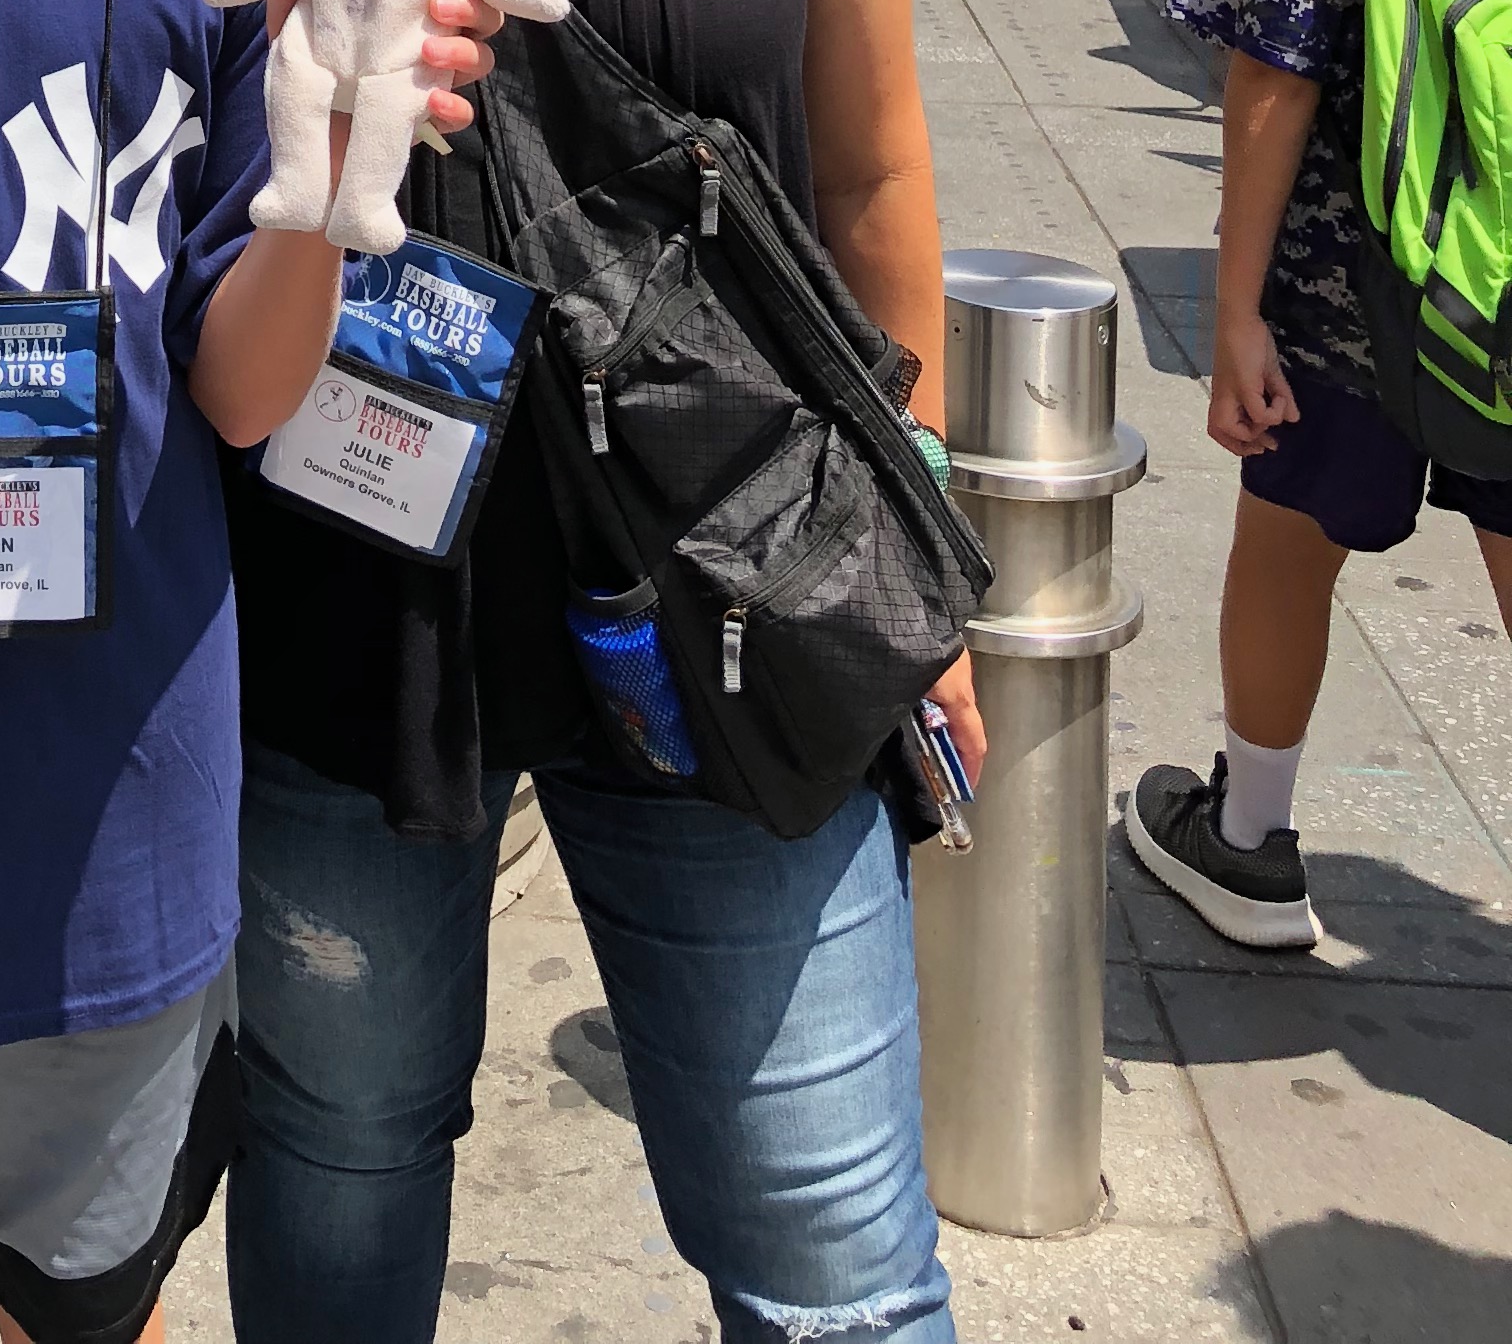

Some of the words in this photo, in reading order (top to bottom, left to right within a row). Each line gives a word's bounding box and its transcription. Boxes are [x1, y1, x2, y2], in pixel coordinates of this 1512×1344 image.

[0, 61, 206, 294] NY
[395, 277, 488, 334] BASEBALL
[405, 266, 425, 283] JAY
[429, 277, 493, 310] BUCKLEY'S
[341, 301, 403, 338] buckley.com
[390, 299, 483, 356] TOURS
[367, 395, 382, 410] JAY
[357, 419, 424, 459] TOURS
[360, 405, 428, 444] BASEBALL
[339, 458, 385, 485] Quinlan
[343, 440, 394, 471] JULIE
[303, 457, 355, 488] Downers
[358, 483, 396, 509] Grove,
[399, 500, 411, 514] IL
[37, 578, 49, 590] IL
